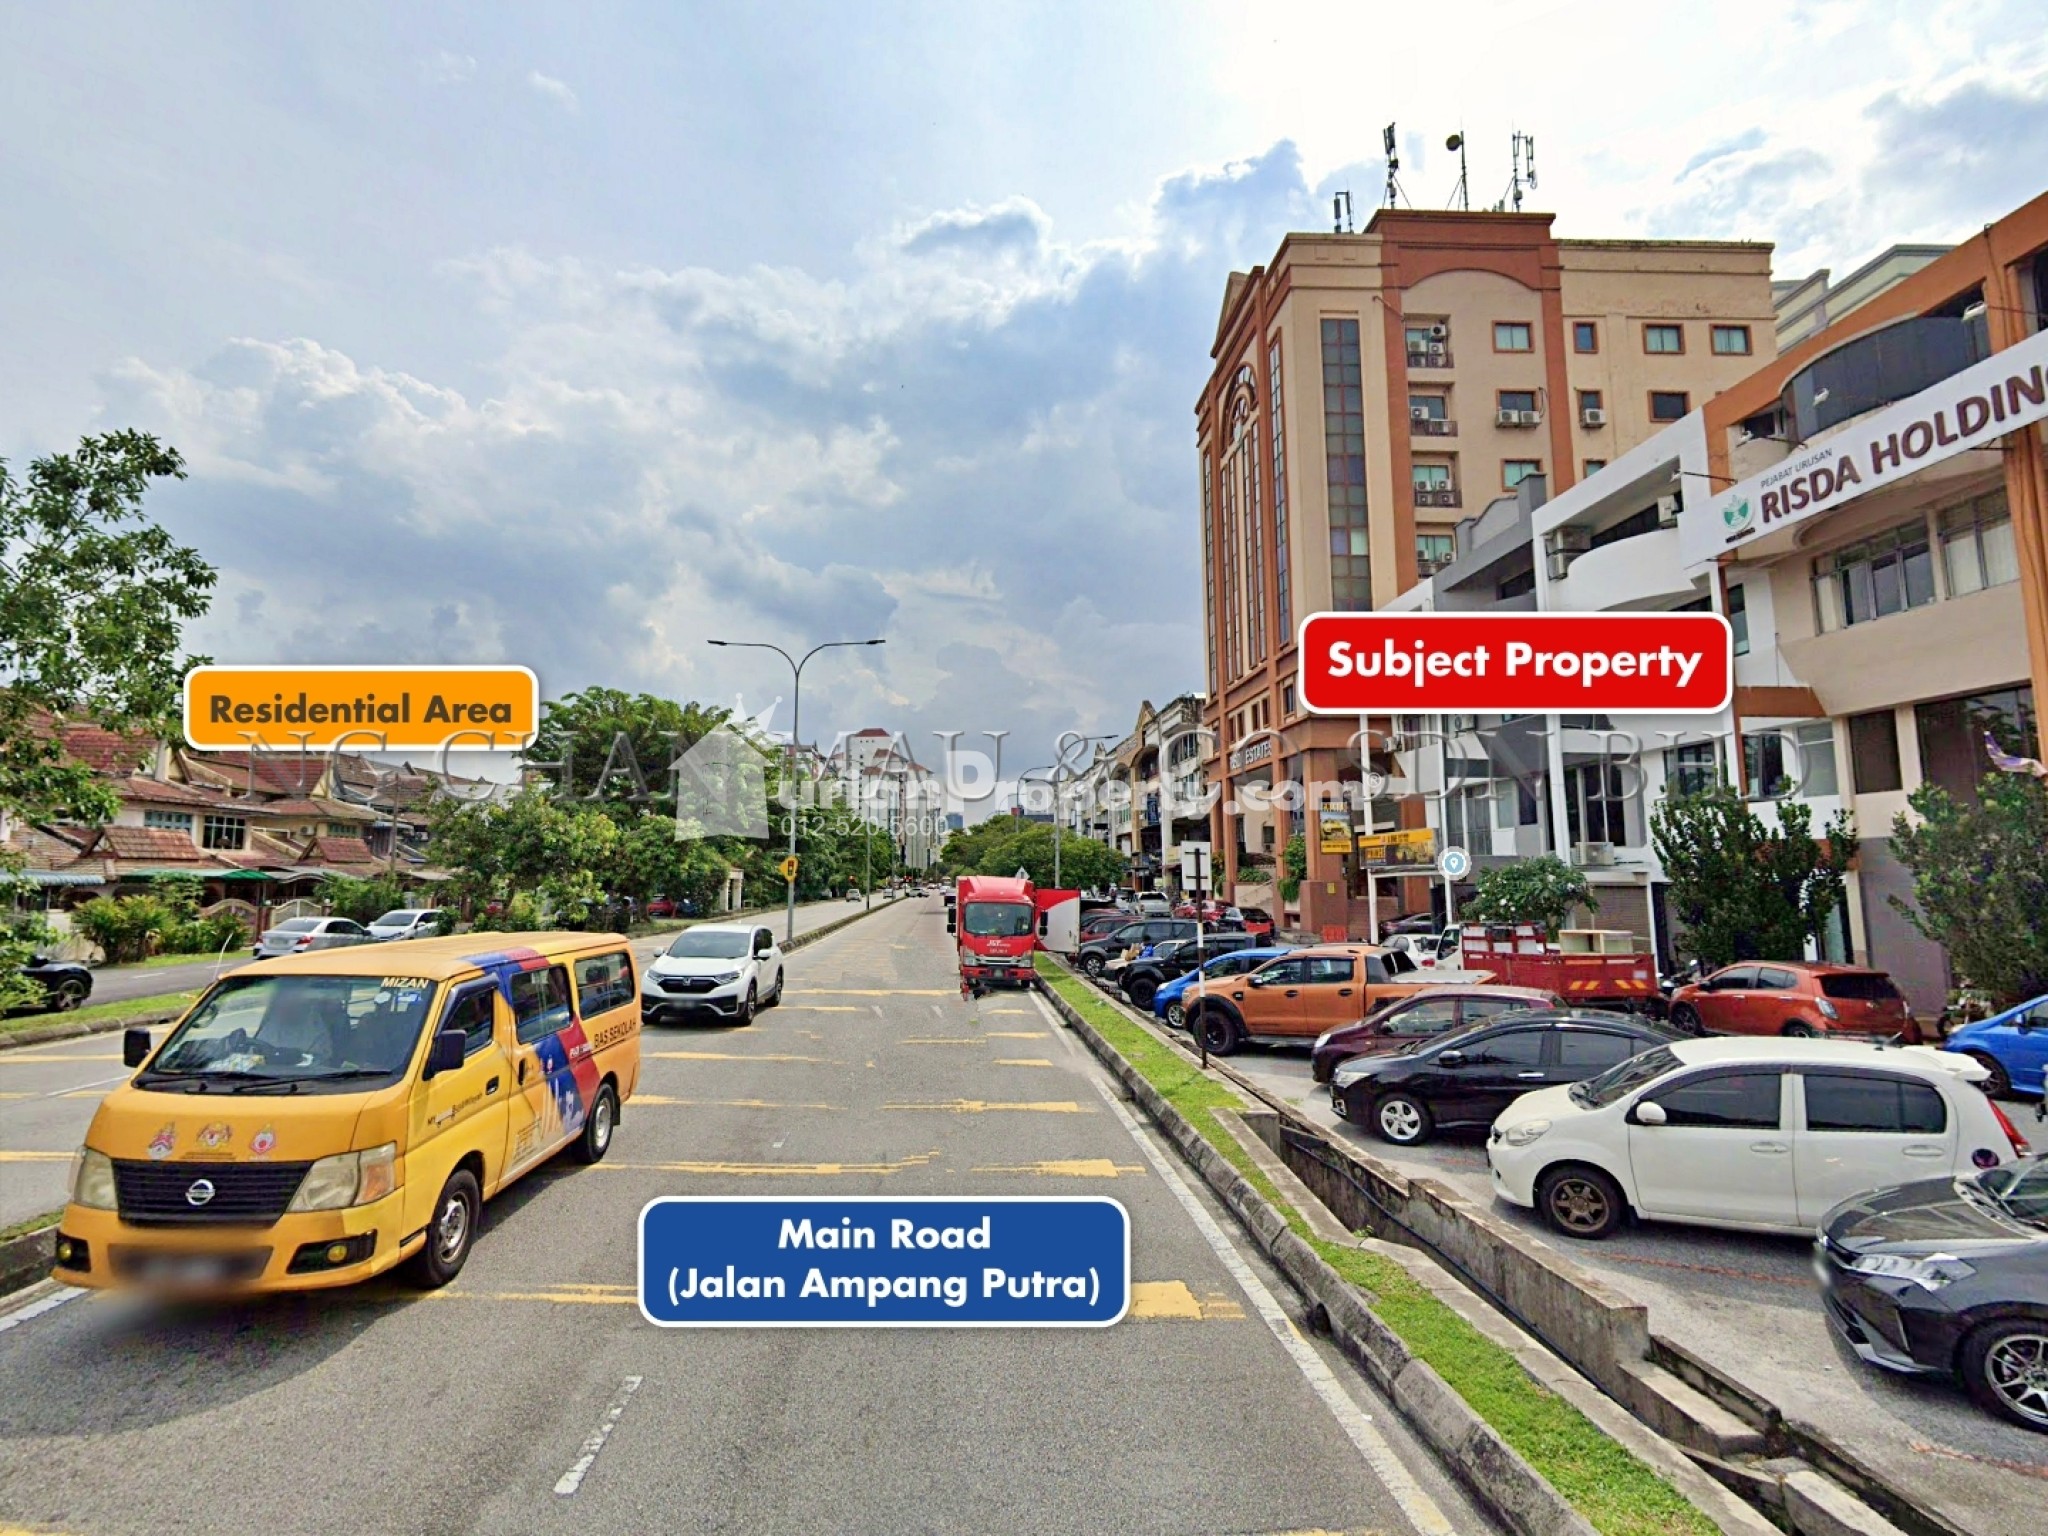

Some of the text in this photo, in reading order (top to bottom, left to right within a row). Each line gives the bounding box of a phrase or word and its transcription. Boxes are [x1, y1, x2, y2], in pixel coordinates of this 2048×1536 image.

[1761, 365, 2048, 523] RISDA HOLDIN
[1761, 448, 1833, 488] PEJABAT URUSAN
[381, 976, 429, 988] MIZAN
[594, 1017, 637, 1048] BAS SEKOLAH
